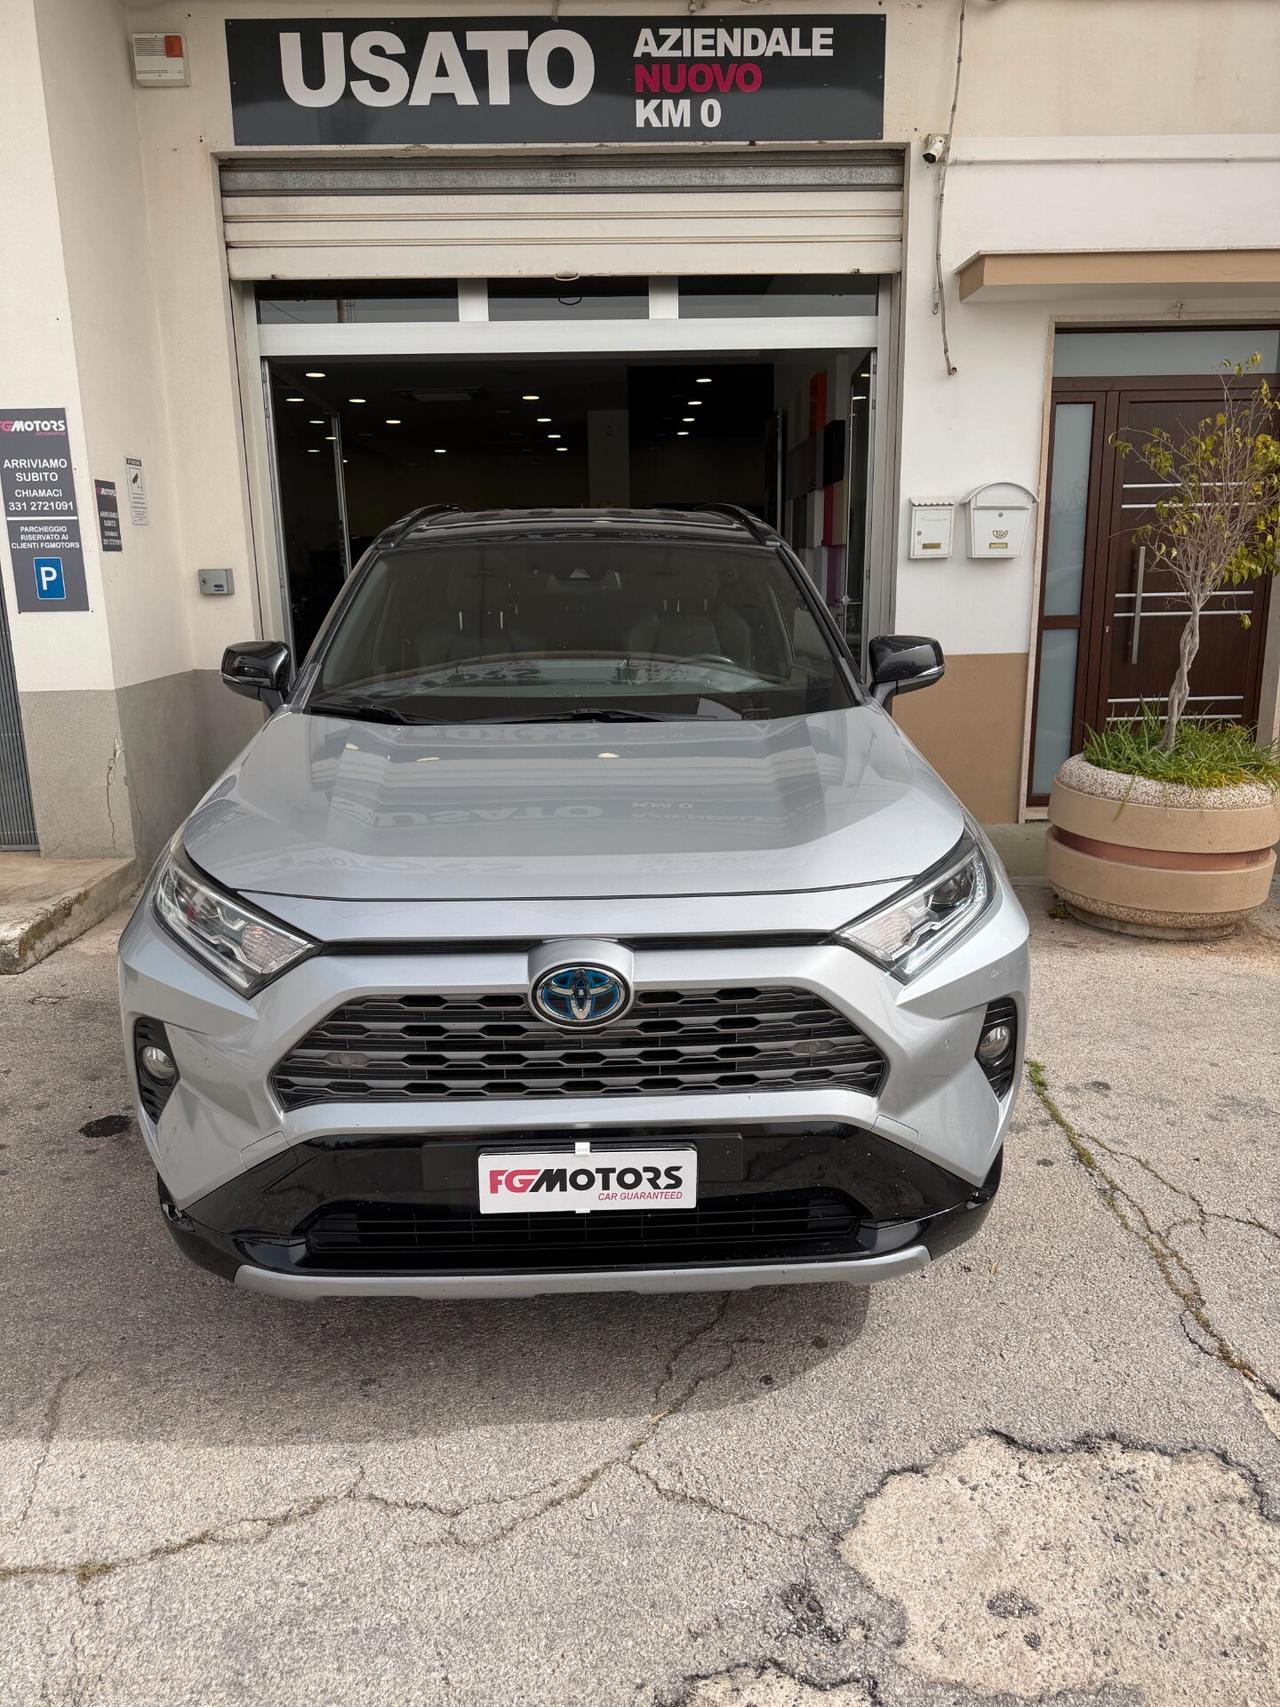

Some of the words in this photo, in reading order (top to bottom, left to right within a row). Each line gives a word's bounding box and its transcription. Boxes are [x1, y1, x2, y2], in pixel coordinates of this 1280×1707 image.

[633, 28, 834, 58] AZIENDALE
[280, 29, 595, 108] USATO
[634, 63, 763, 94] NUOVO
[635, 99, 691, 128] KM
[700, 99, 722, 128] 0
[3, 458, 68, 468] ARRIVIAMO
[15, 472, 59, 482] SUBITO
[14, 489, 63, 498] CHIAMACI
[8, 502, 27, 511] 331
[30, 501, 74, 511] 2721091
[19, 525, 68, 533] PARCHEGGIO
[20, 533, 60, 541] RISERVATO
[61, 533, 69, 541] AI
[40, 541, 80, 549] FGMOTORS
[40, 566, 58, 591] P
[489, 1165, 683, 1194] FGMOTORS
[598, 1193, 618, 1201] CAR
[619, 1191, 683, 1200] GUARANTEED
